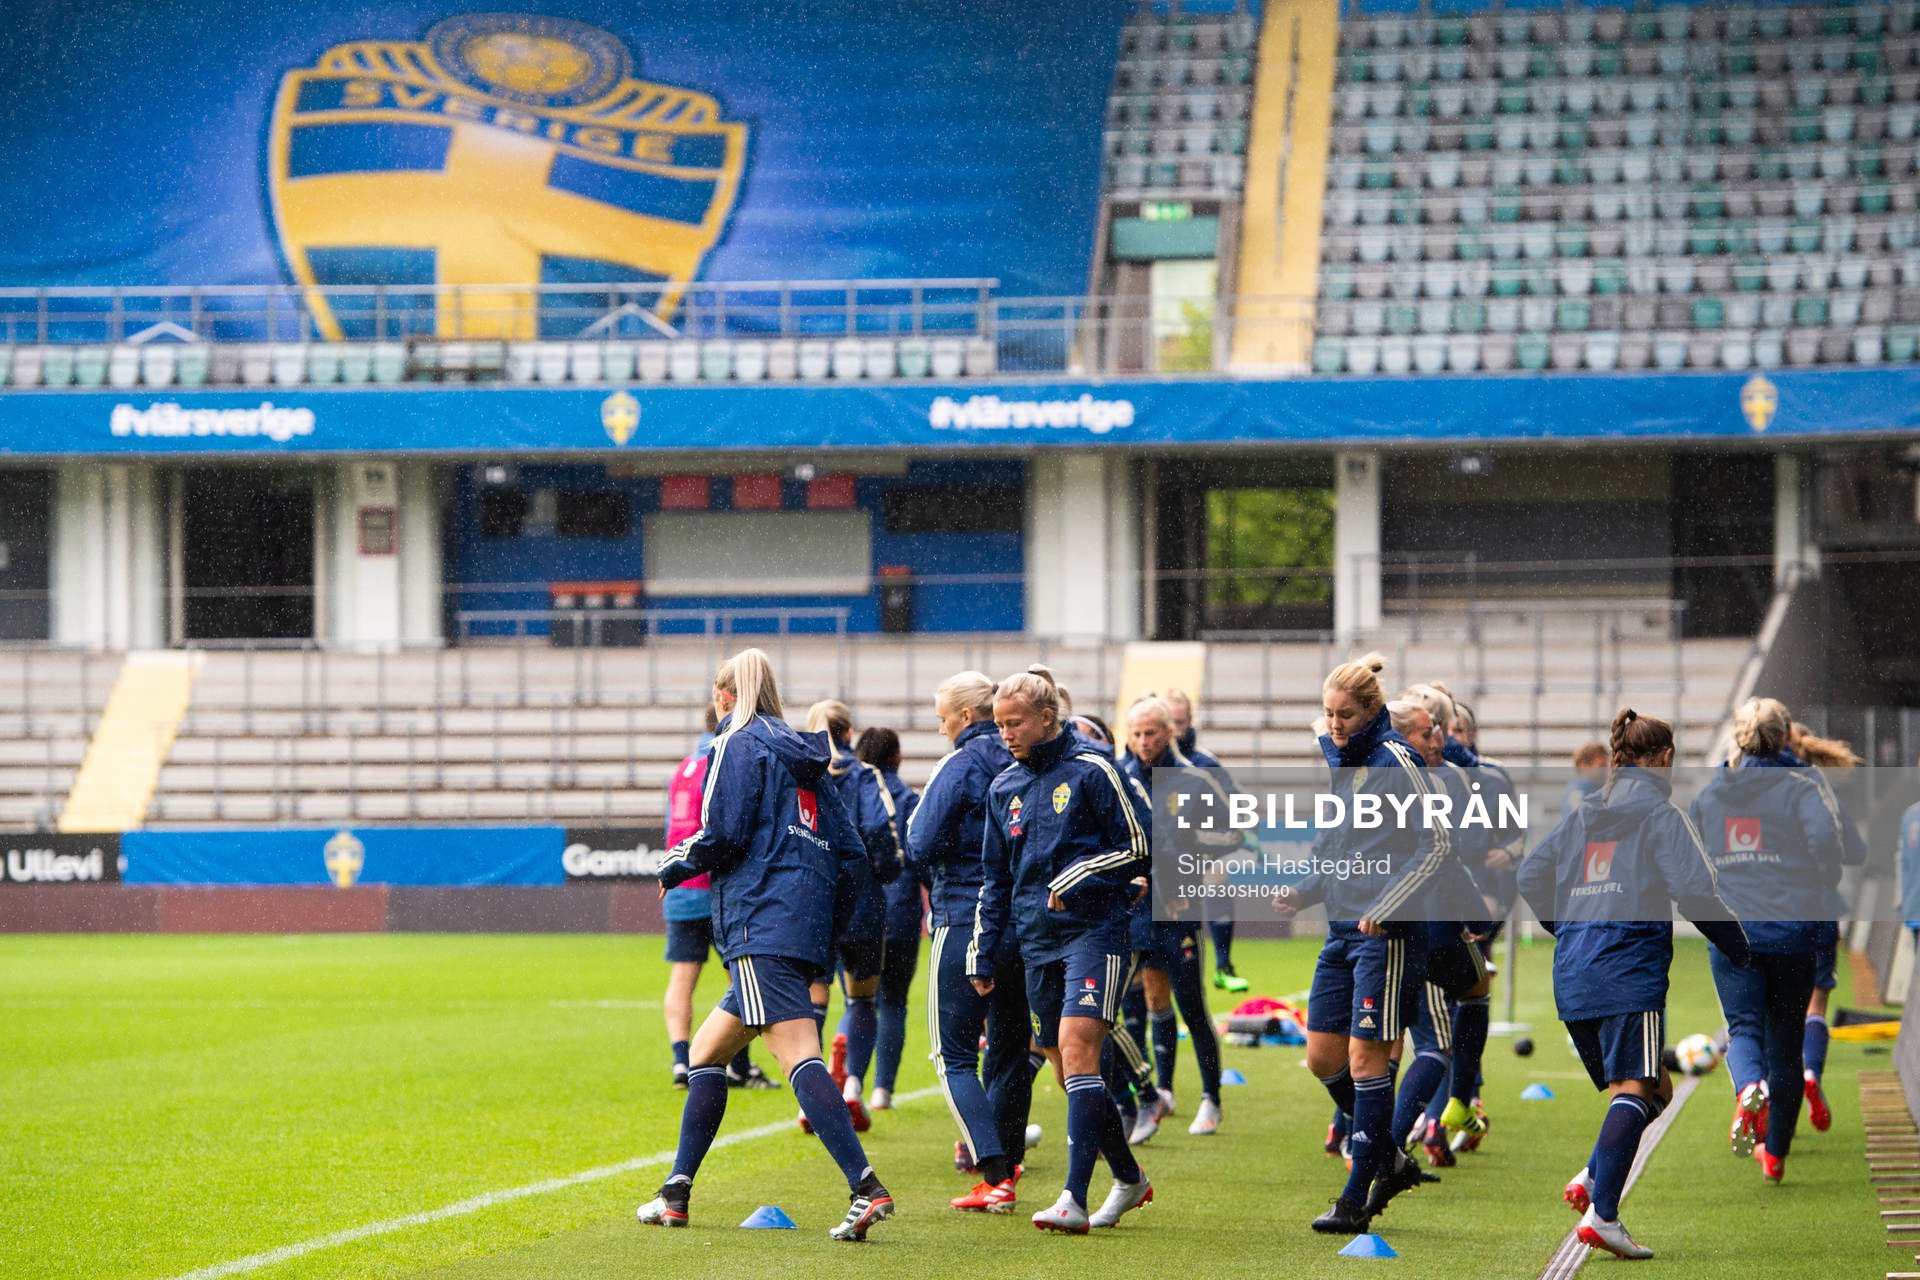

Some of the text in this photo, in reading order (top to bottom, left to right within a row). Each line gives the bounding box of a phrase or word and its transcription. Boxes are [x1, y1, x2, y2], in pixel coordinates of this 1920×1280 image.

[343, 79, 674, 164] SVERIGE
[7, 848, 104, 882] Ullevi
[1570, 885, 1602, 898] VENSKA
